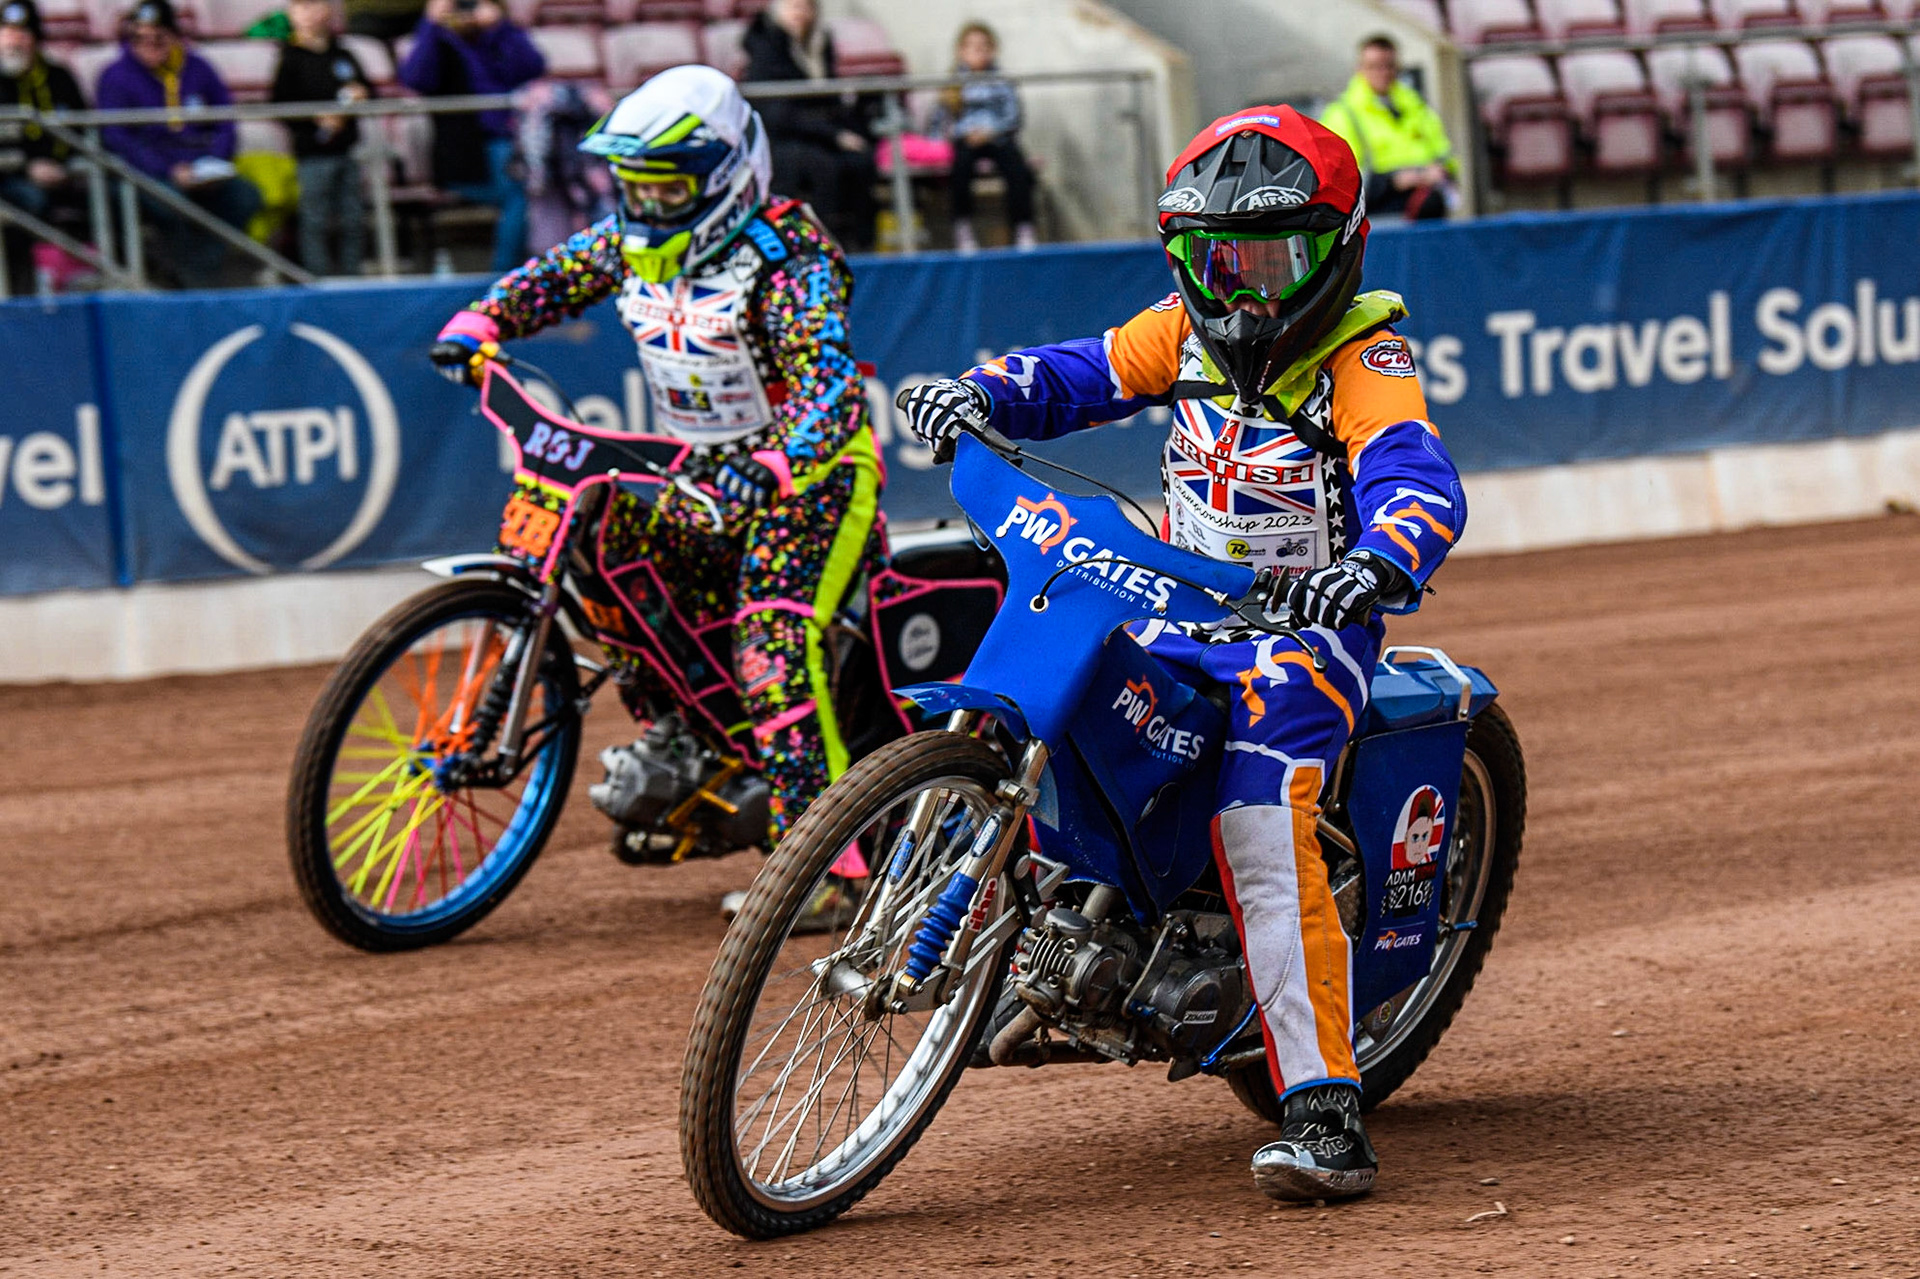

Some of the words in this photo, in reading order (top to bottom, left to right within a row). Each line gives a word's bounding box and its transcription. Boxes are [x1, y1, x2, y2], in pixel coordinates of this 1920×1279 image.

[1247, 189, 1304, 210] Airoh
[1486, 292, 1732, 398] Travel
[1755, 278, 1920, 376] Solu
[0, 404, 104, 509] el
[210, 407, 358, 490] ATPI
[1170, 427, 1311, 484] BRITISH
[1263, 515, 1313, 530] 2023
[1001, 504, 1059, 546] PW
[1063, 537, 1177, 604] GATES
[1056, 560, 1136, 603] DSTRIBUTION
[1112, 687, 1149, 726] PW
[1146, 715, 1205, 760] GATES
[1385, 868, 1416, 887] ADAM
[1394, 881, 1424, 909] 216
[1394, 933, 1422, 948] GATES
